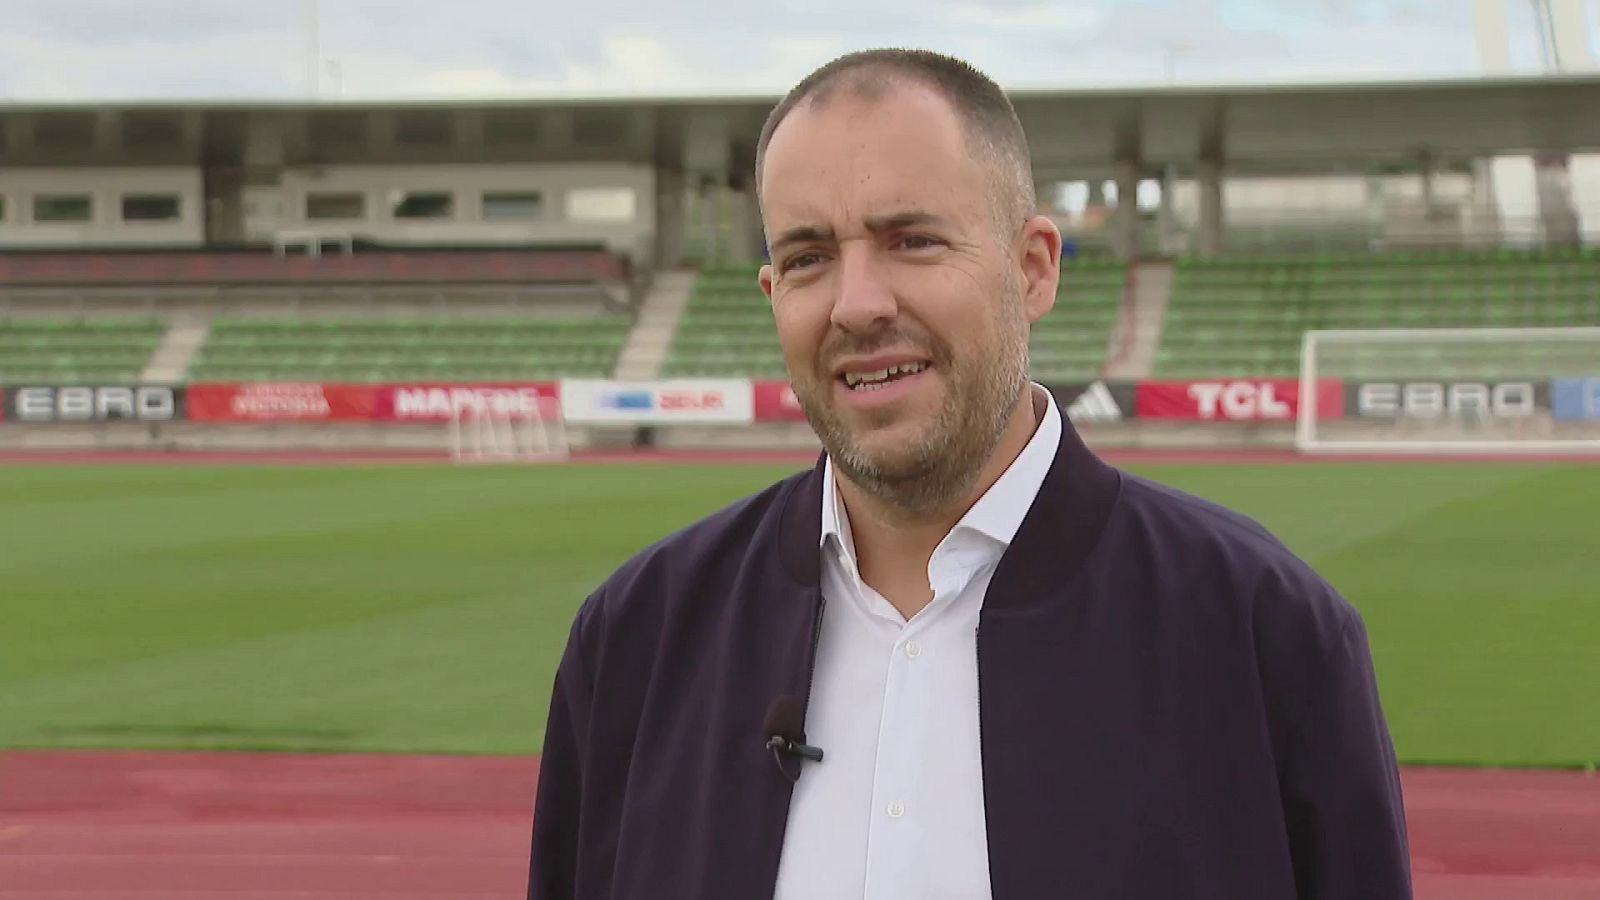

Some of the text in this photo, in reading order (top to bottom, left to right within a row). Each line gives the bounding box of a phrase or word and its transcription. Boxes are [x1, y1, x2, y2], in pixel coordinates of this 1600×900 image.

[16, 386, 174, 420] EBRO
[1188, 382, 1289, 419] TCL
[1358, 382, 1534, 418] EBRO
